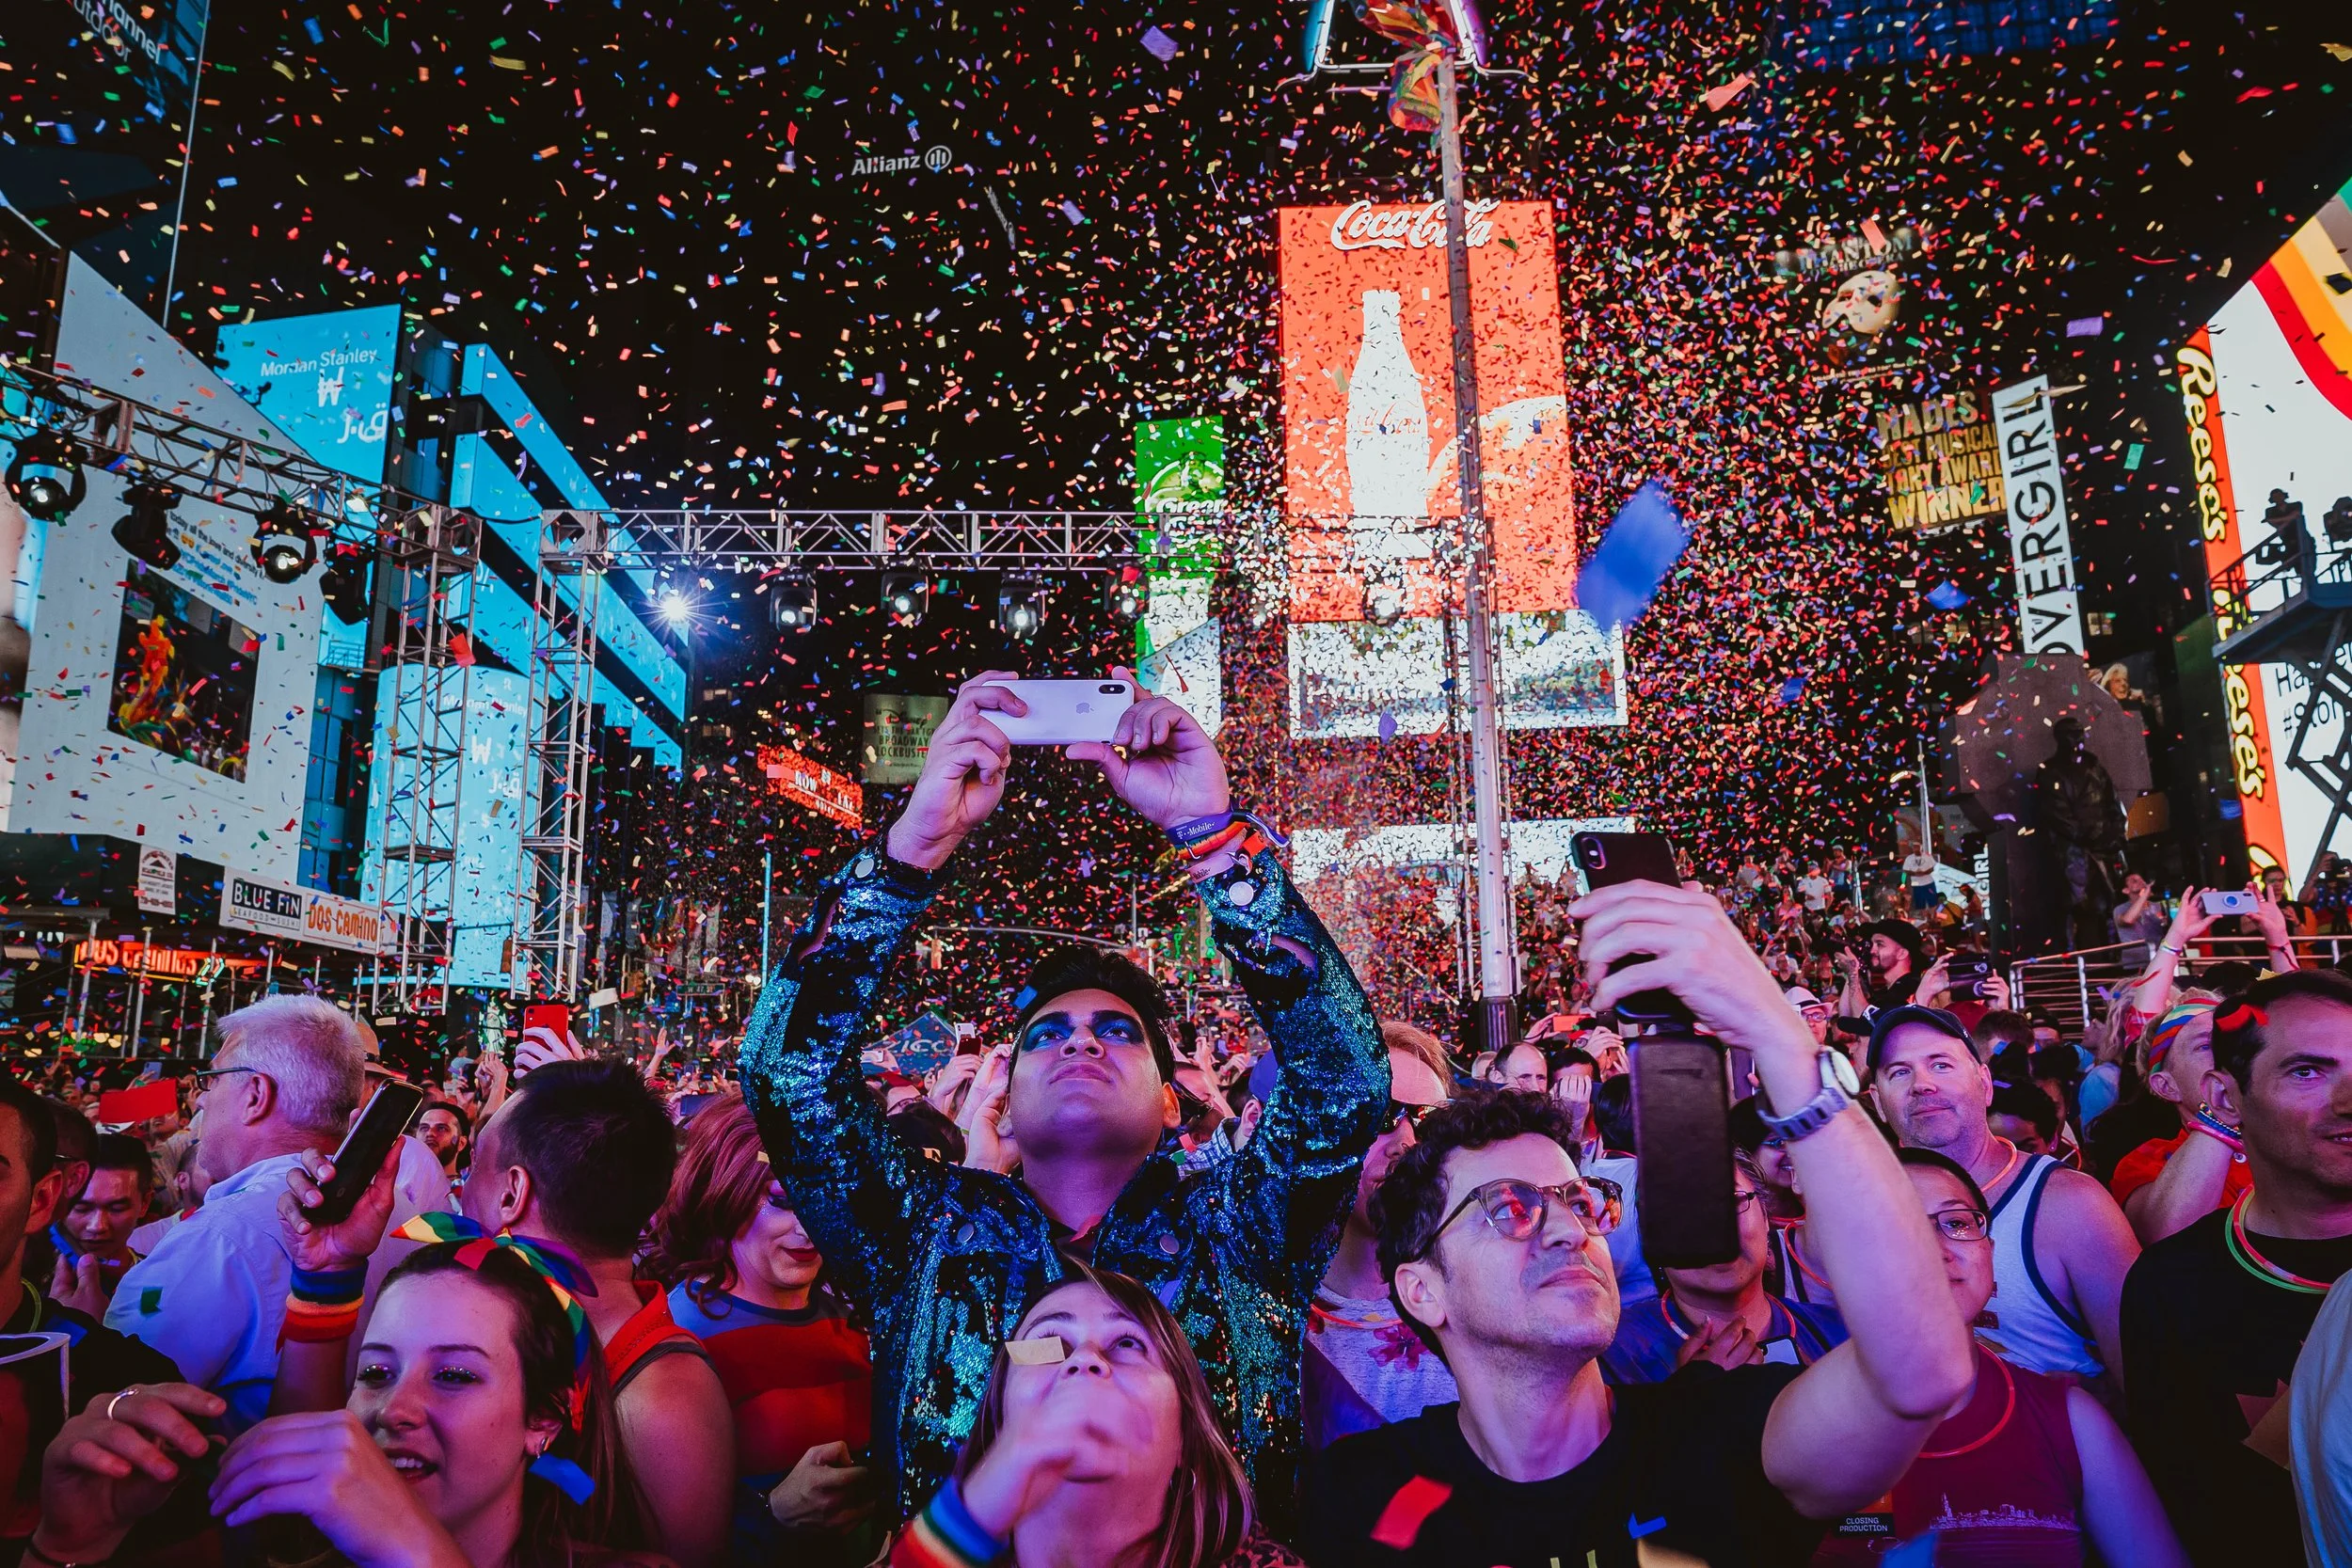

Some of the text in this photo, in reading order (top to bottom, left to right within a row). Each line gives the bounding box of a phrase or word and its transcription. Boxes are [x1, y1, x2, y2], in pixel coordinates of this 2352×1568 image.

[851, 154, 921, 176] Allianz
[320, 348, 377, 366] Stanley
[2176, 347, 2229, 542] Reese's
[1887, 475, 2007, 530] WINNER
[443, 694, 489, 711] Mogan
[879, 735, 930, 746] BROADWAY
[875, 746, 927, 758] LOCKBUSTE
[233, 882, 271, 911] BLUE
[308, 904, 378, 942] DOS CAMINO
